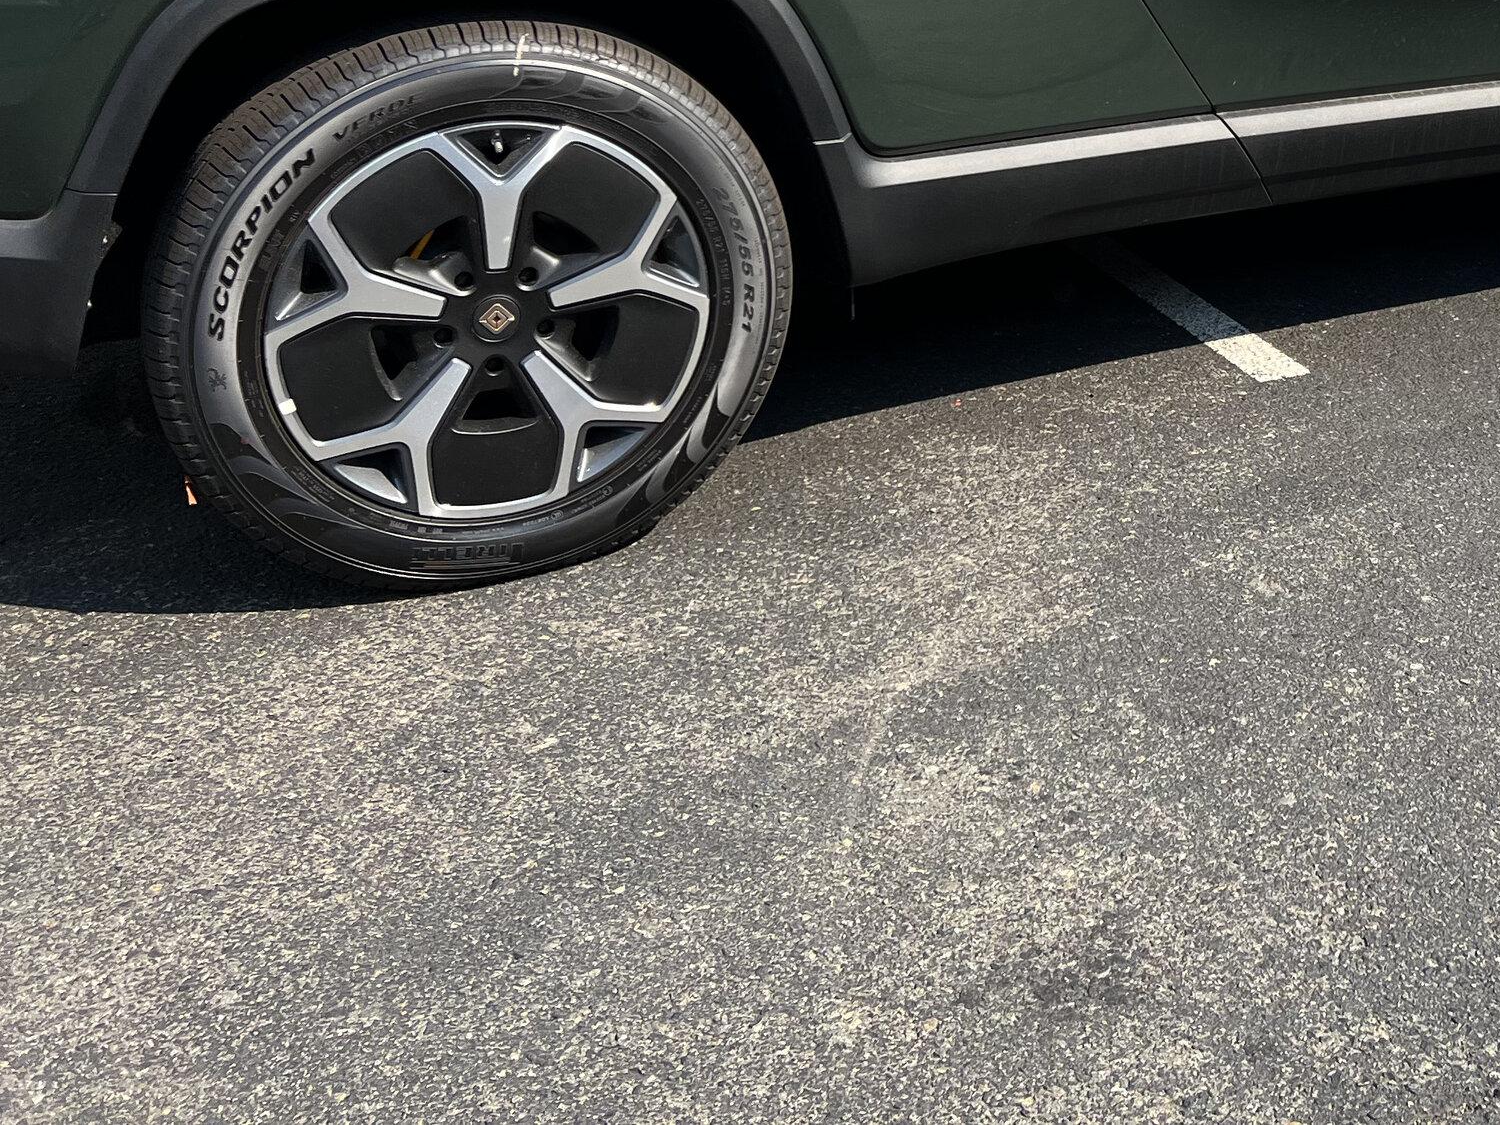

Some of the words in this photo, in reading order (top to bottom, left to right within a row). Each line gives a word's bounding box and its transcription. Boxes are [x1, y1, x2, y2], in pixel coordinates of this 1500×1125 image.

[208, 148, 317, 341] SCORPION
[712, 186, 754, 277] 275/55
[741, 283, 755, 333] R21
